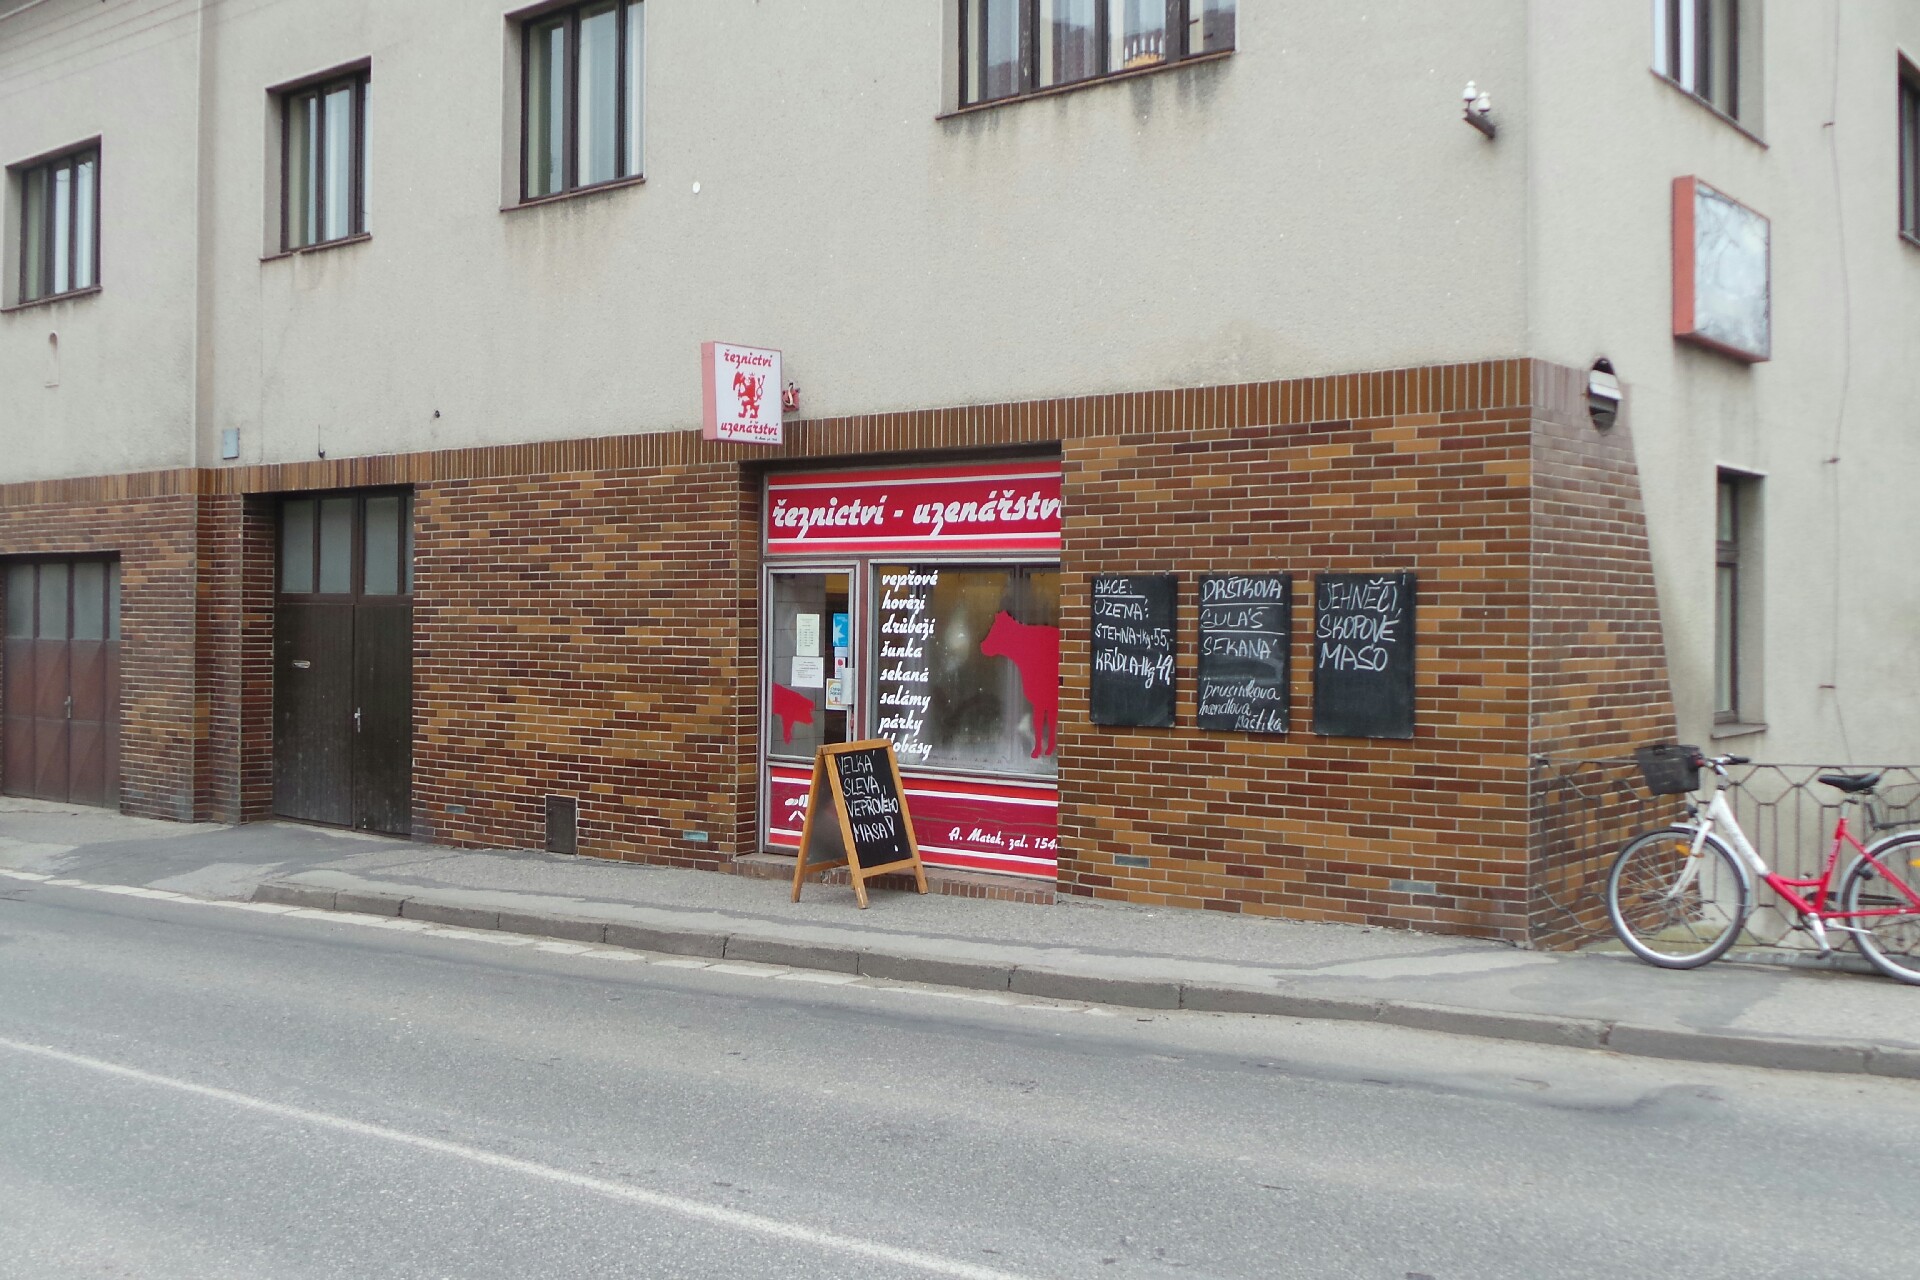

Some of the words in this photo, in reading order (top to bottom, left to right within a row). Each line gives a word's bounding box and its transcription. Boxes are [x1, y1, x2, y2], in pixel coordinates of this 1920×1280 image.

[720, 420, 778, 438] uzenářství
[772, 495, 888, 539] řeznictví
[881, 569, 939, 592] vepřové
[881, 589, 927, 615] hovězí
[881, 613, 936, 640] drůbeží
[1316, 608, 1402, 643] SKOPOVÉ
[880, 637, 923, 658] šunka
[1203, 636, 1278, 660] SEKANÁ
[1319, 642, 1389, 671] MASO
[879, 660, 930, 682] sekaná
[879, 685, 931, 713] salámy
[878, 709, 923, 737] párky
[837, 750, 876, 776] VELKÁ
[843, 775, 880, 797] SLEVA
[948, 827, 963, 842] A.
[1034, 837, 1057, 849] 154
